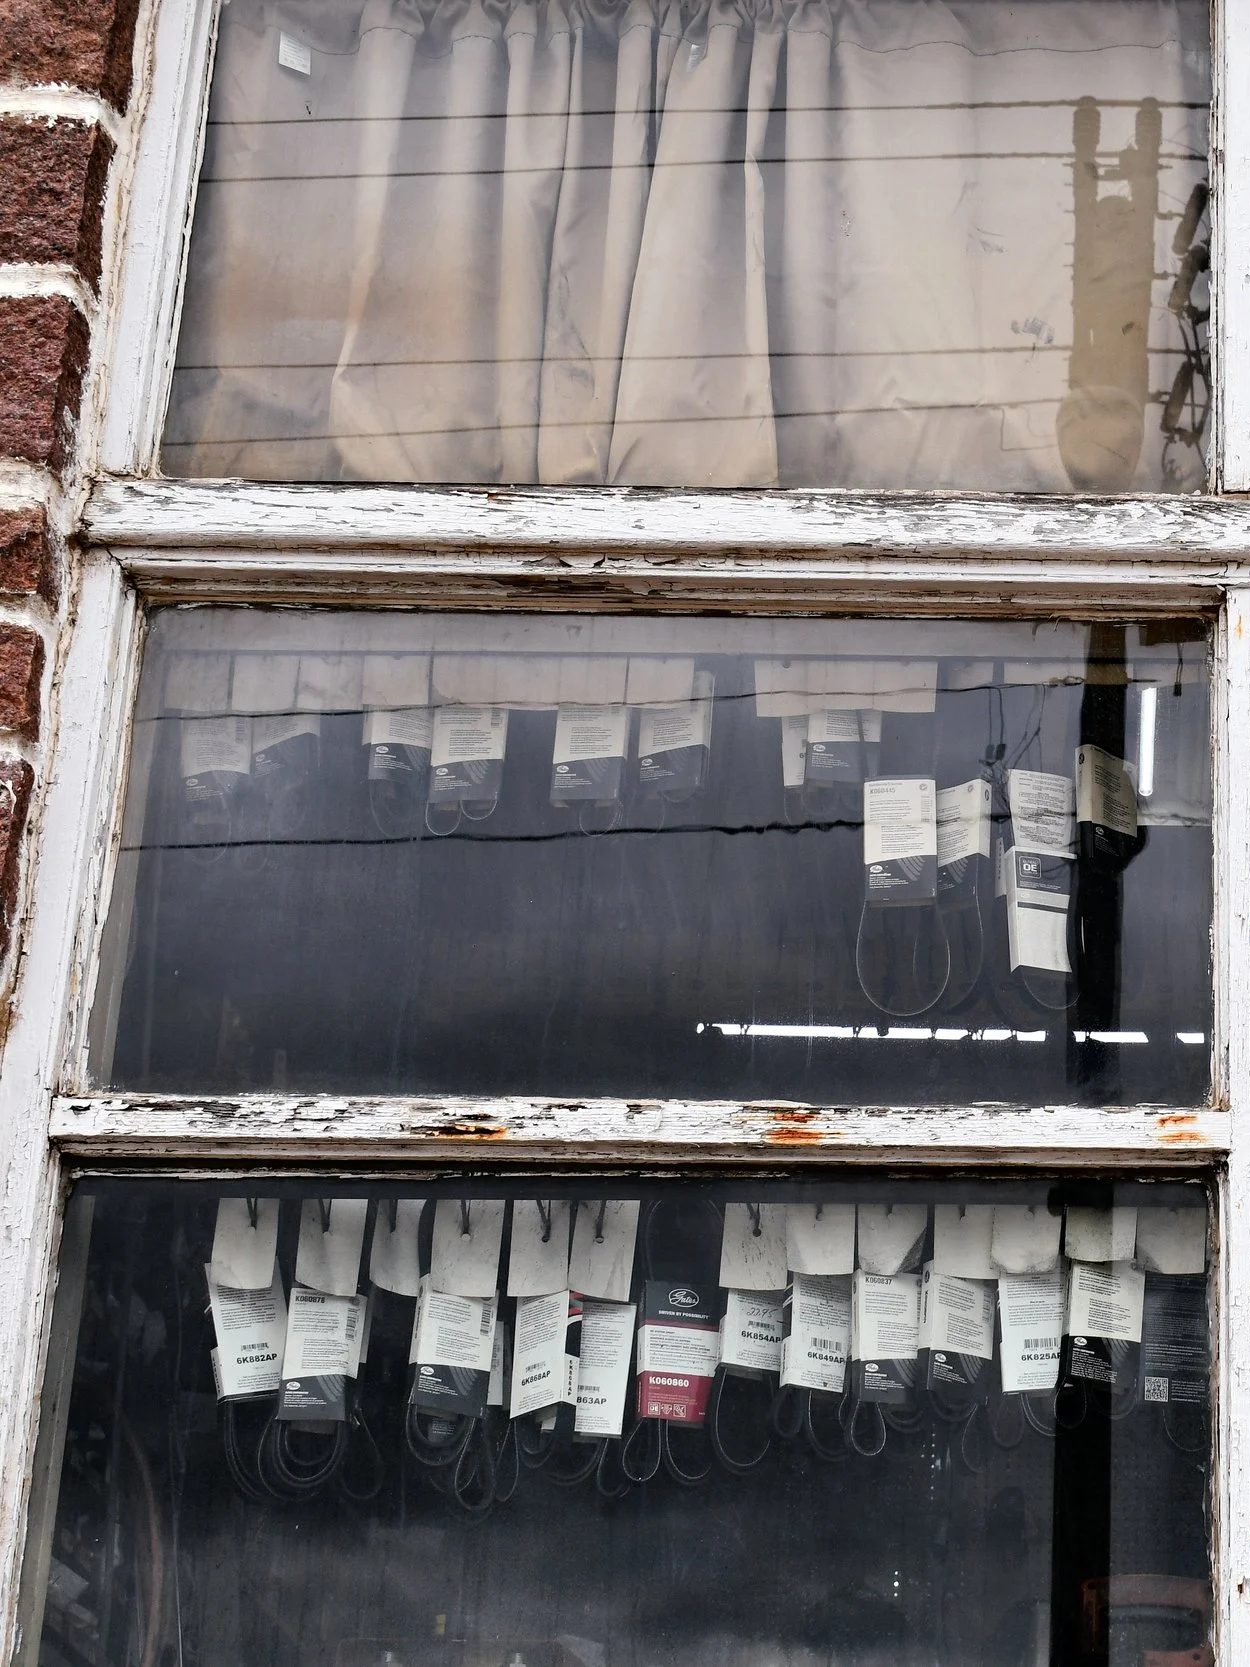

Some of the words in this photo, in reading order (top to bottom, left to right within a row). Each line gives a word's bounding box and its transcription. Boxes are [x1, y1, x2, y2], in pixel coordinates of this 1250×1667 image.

[669, 1290, 697, 1305] Gates
[741, 1330, 782, 1343] 6K854AP
[236, 1353, 278, 1365] 6K882AP
[807, 1351, 845, 1364] 6K849AP
[521, 1370, 551, 1386] 6K868AP
[649, 1376, 690, 1388] K060860
